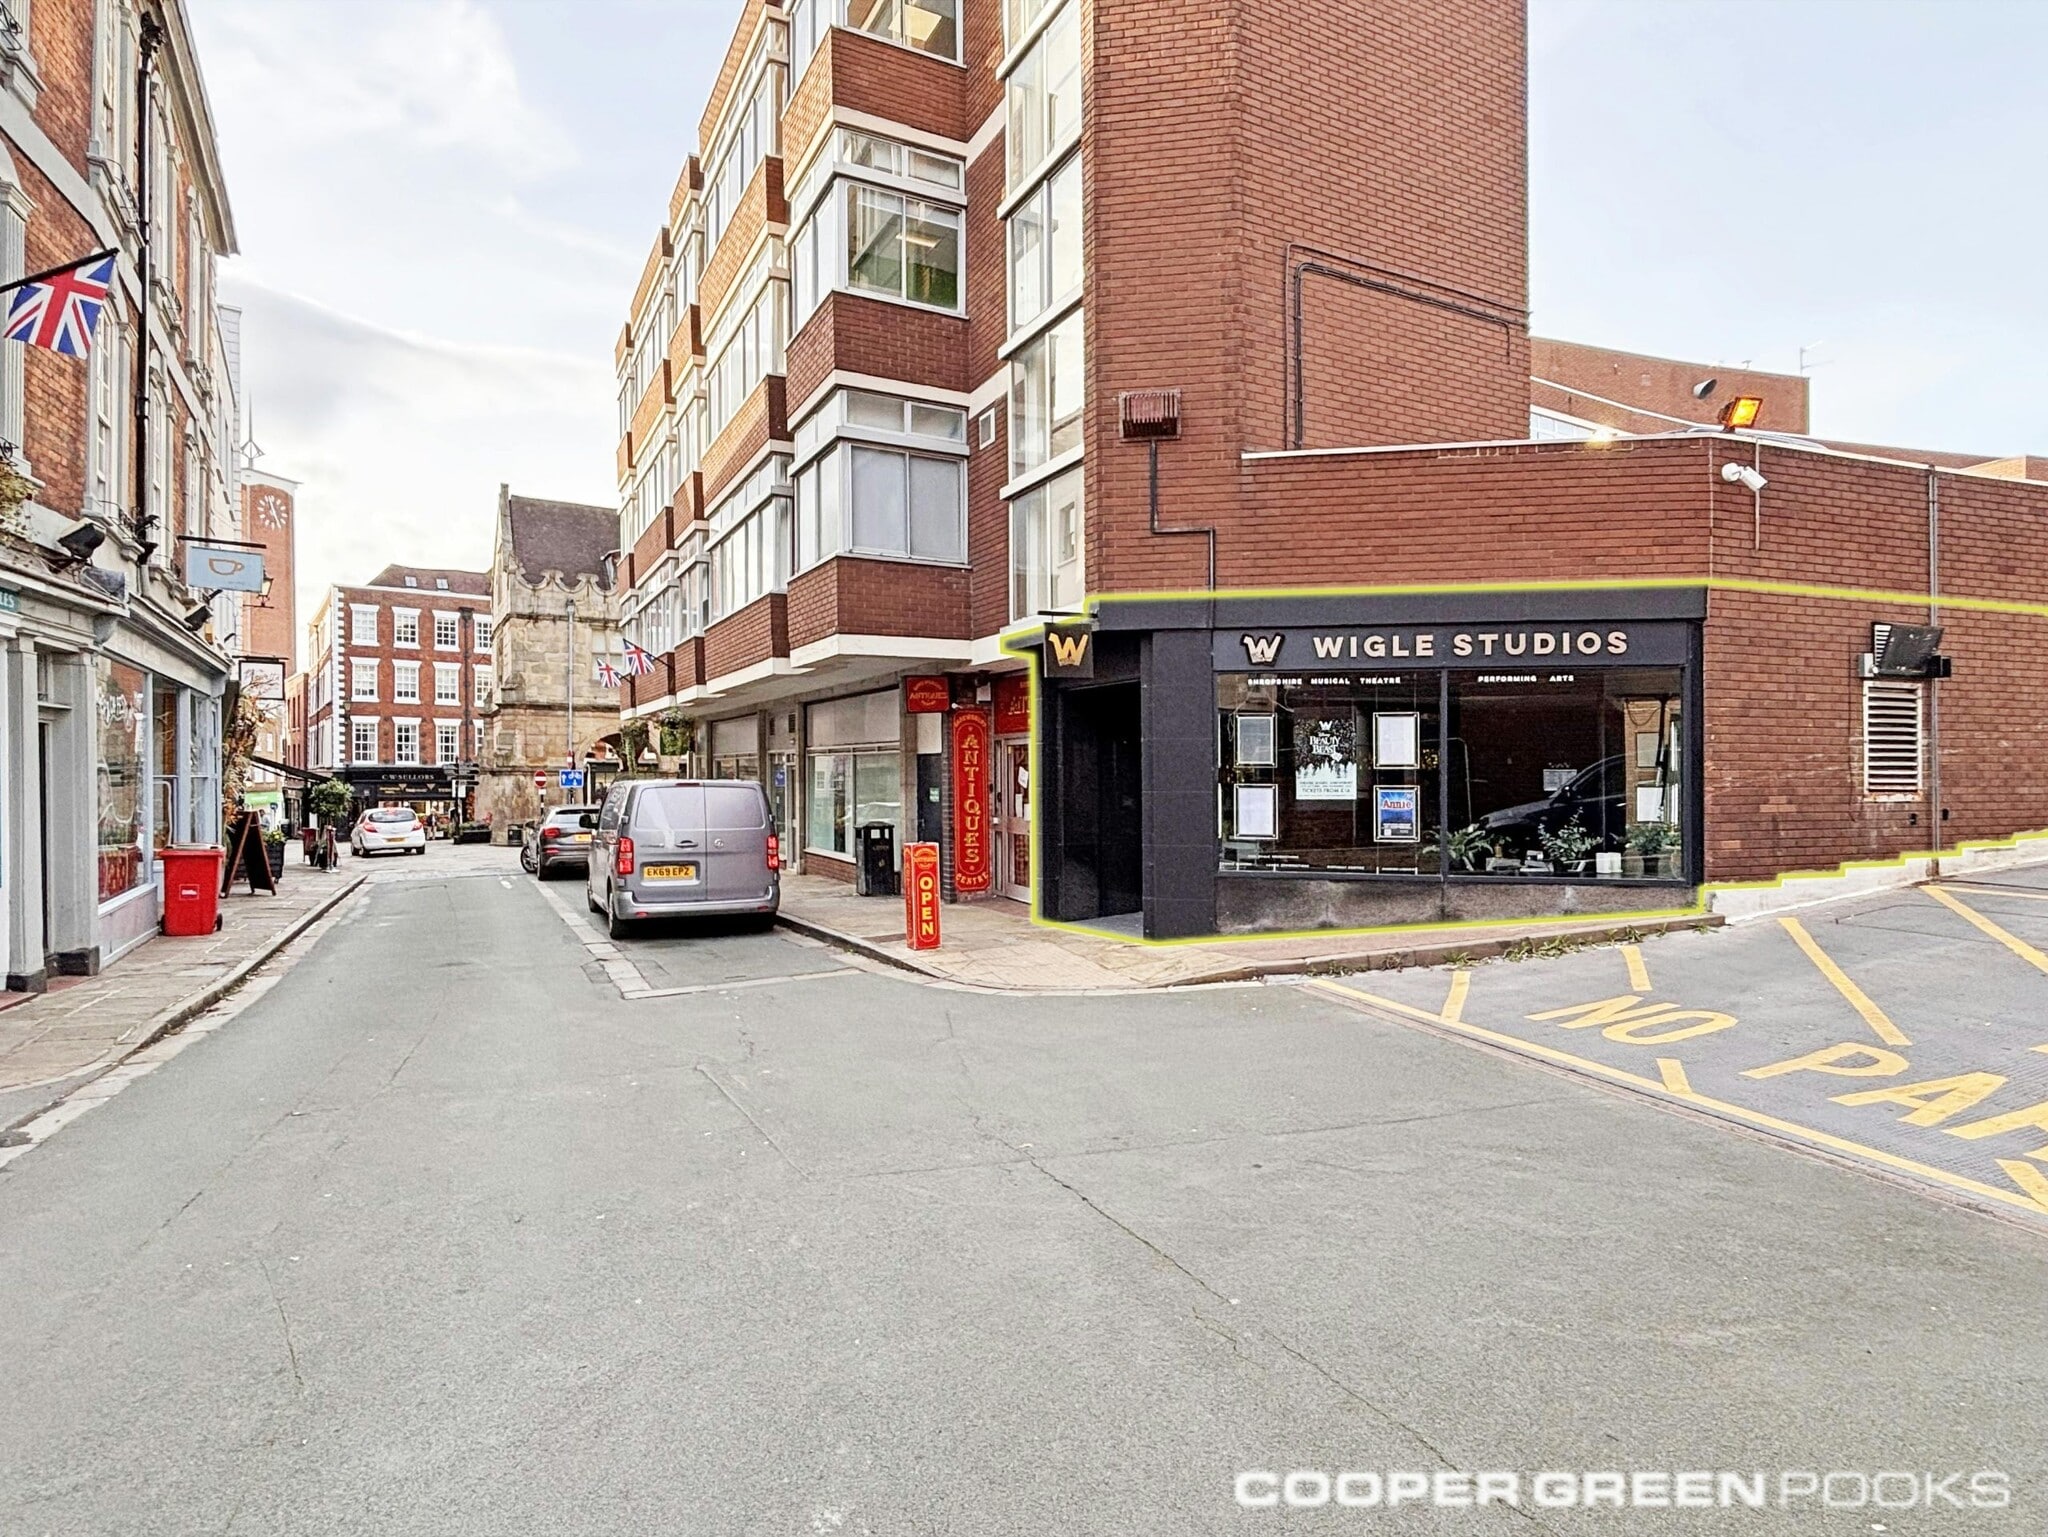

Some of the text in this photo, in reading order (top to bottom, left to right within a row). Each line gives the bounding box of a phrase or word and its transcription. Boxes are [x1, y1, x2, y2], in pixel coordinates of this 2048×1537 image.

[1313, 634, 1435, 659] WIGLE
[1452, 631, 1629, 657] STUDIOS
[1247, 676, 1402, 686] SHROPSHIRE MUSICAL THEATRE
[1477, 674, 1575, 683] PERFORMING ARTS
[1309, 735, 1341, 748] BEAUTY
[1312, 745, 1338, 756] BEAST
[960, 734, 981, 864] ANTIQUES
[1383, 799, 1412, 809] Annie
[646, 867, 690, 876] EK69 EPZ
[955, 872, 989, 885] CENTRE
[919, 876, 935, 936] OPEN
[1524, 995, 1739, 1046] NO
